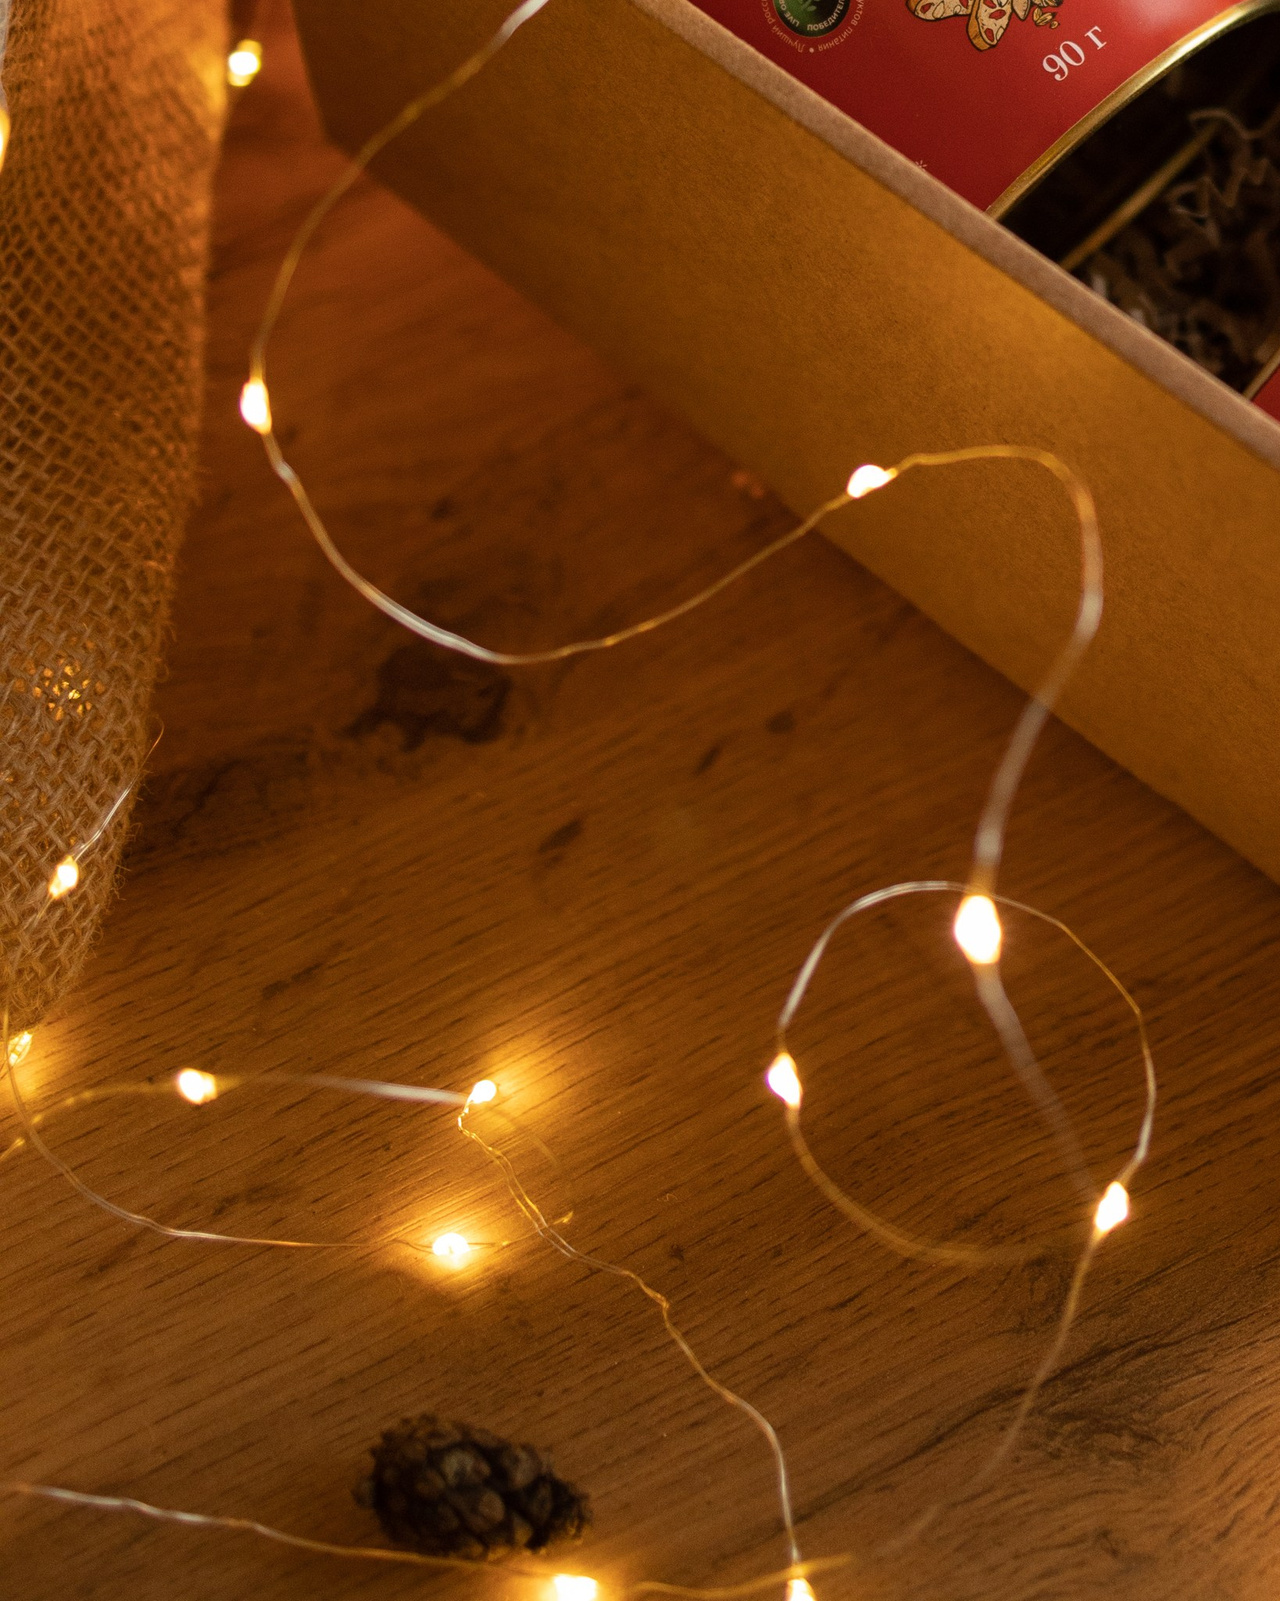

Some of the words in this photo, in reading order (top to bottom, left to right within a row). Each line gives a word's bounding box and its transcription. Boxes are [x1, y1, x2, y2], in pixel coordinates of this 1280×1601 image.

[784, 11, 800, 27] LIVE
[771, 25, 805, 53] Лучший
[818, 27, 853, 51] питания
[1042, 41, 1085, 81] 90
[1084, 26, 1107, 50] г
